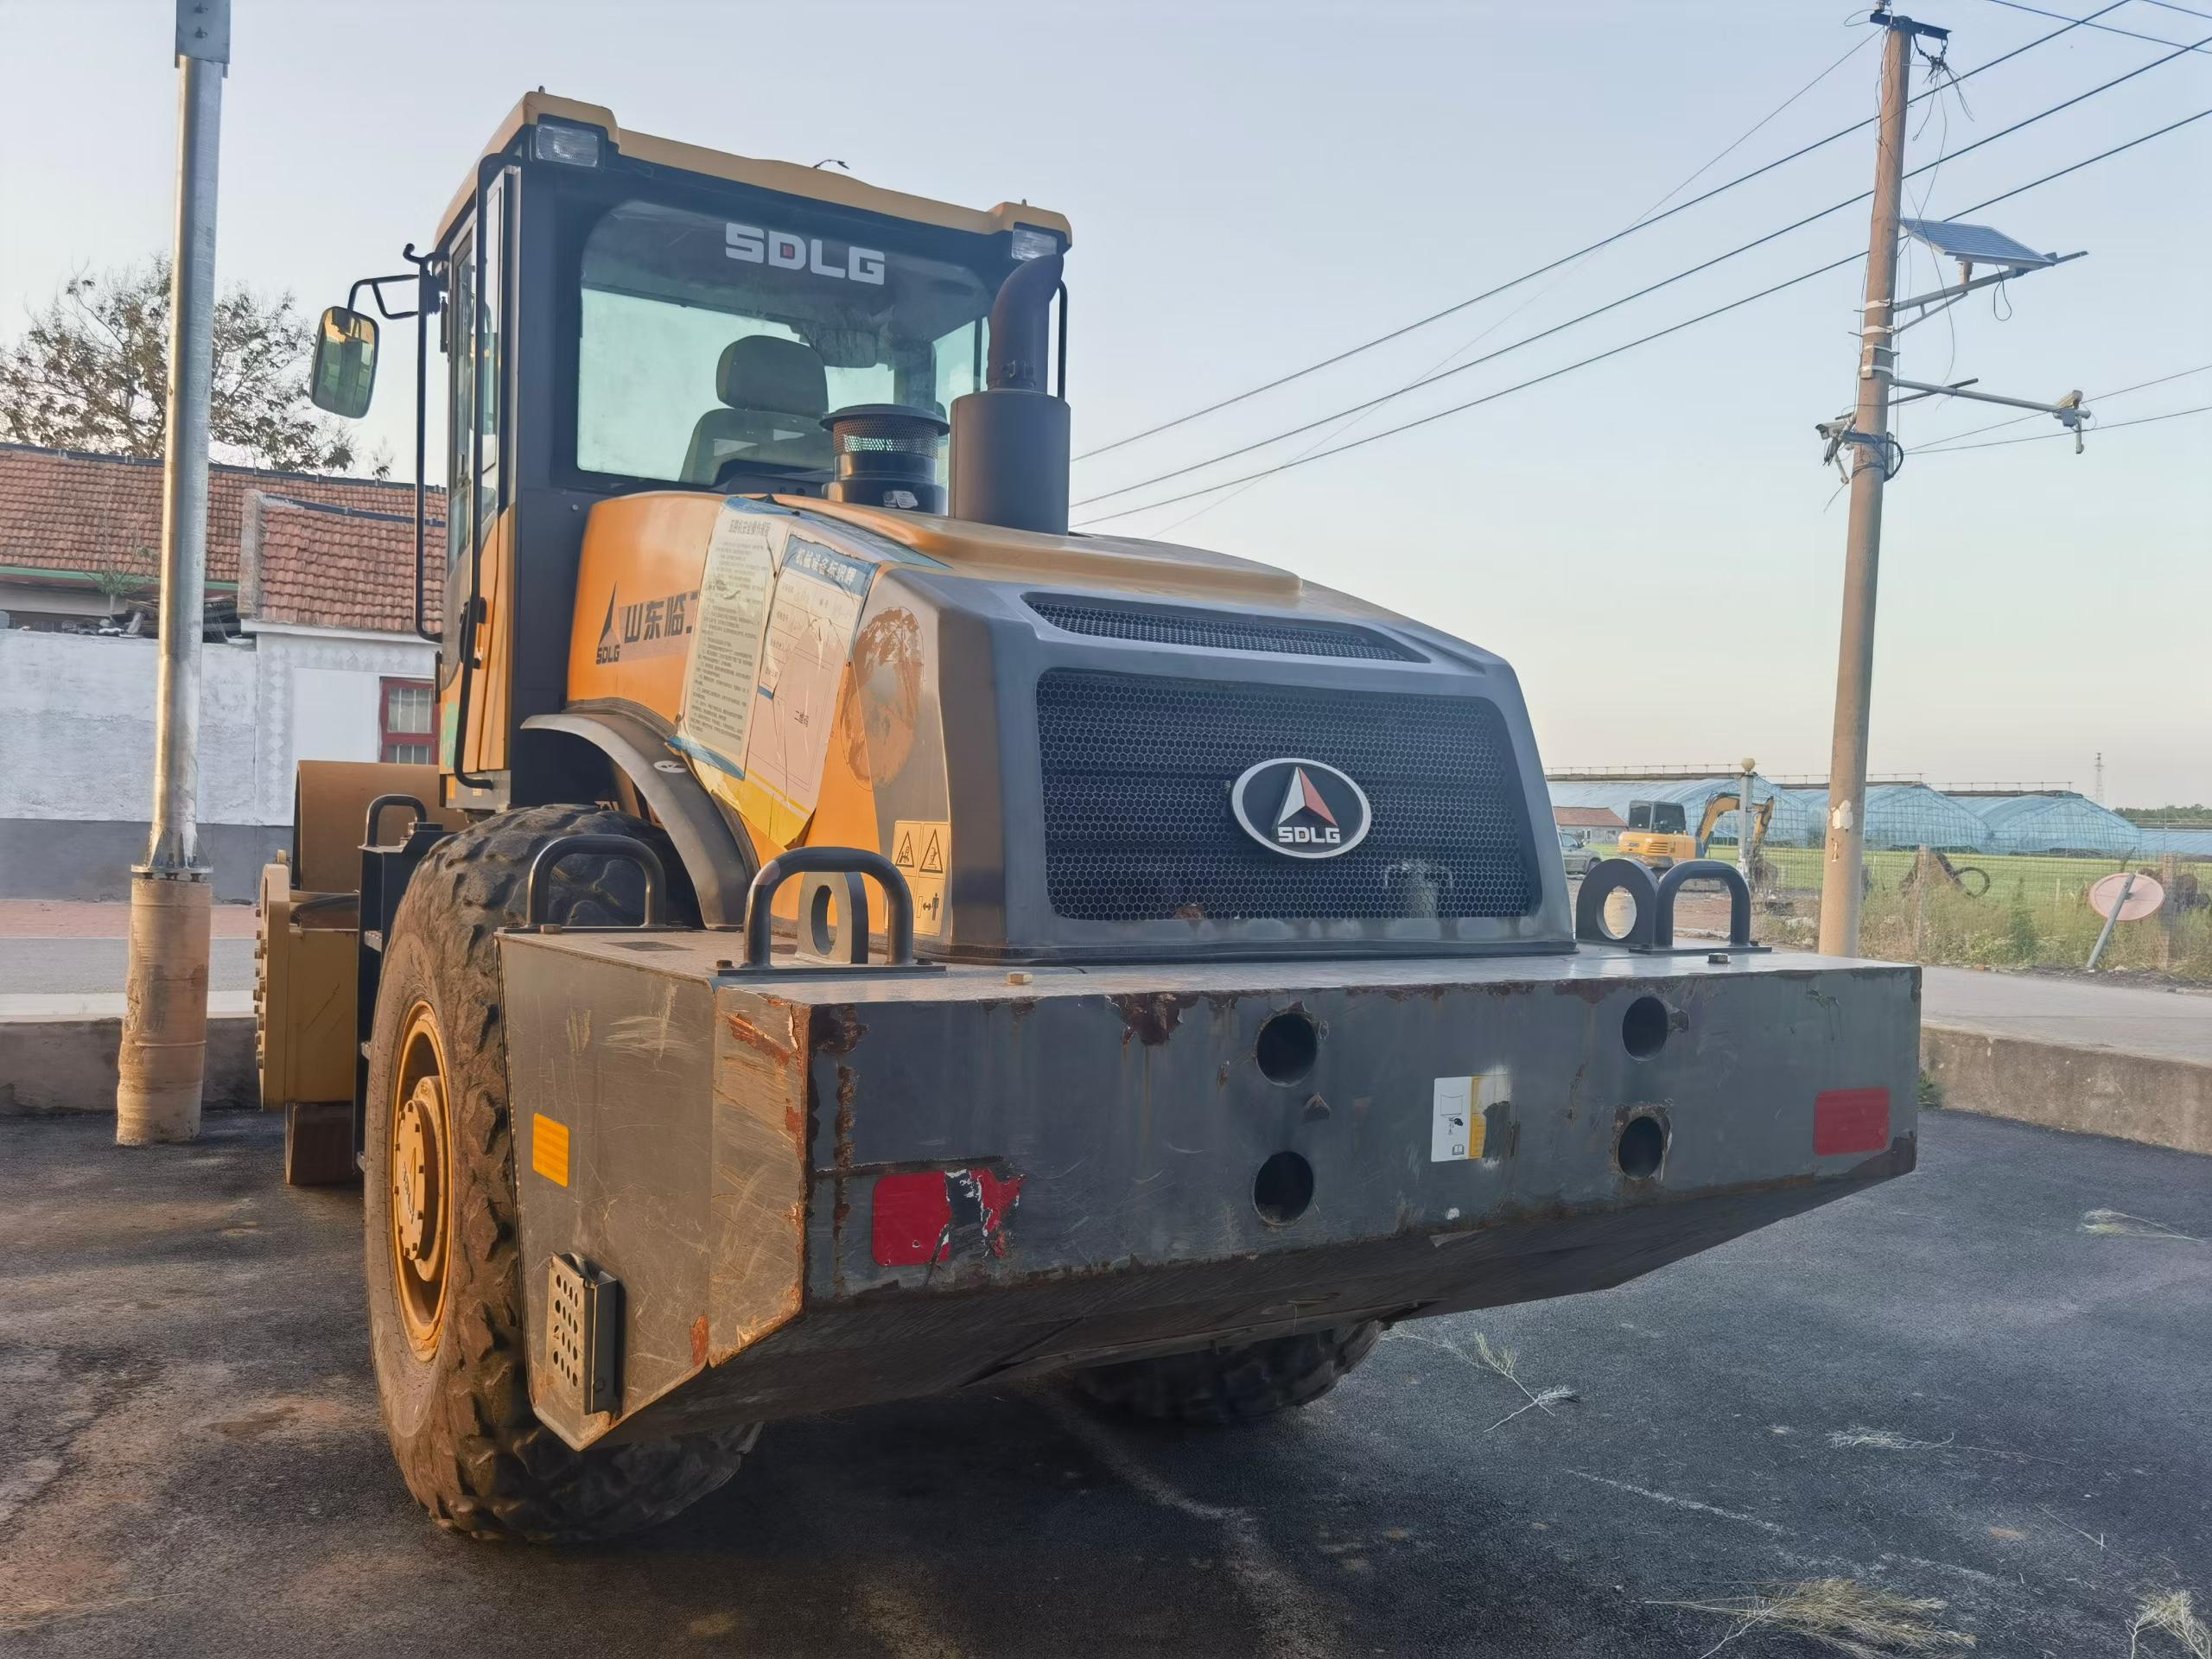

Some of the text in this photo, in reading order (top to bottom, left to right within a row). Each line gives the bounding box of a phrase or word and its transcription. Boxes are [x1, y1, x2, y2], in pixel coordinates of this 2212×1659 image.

[726, 222, 885, 285] SDLG
[596, 644, 620, 664] SDLG
[1277, 826, 1340, 843] SDLG
